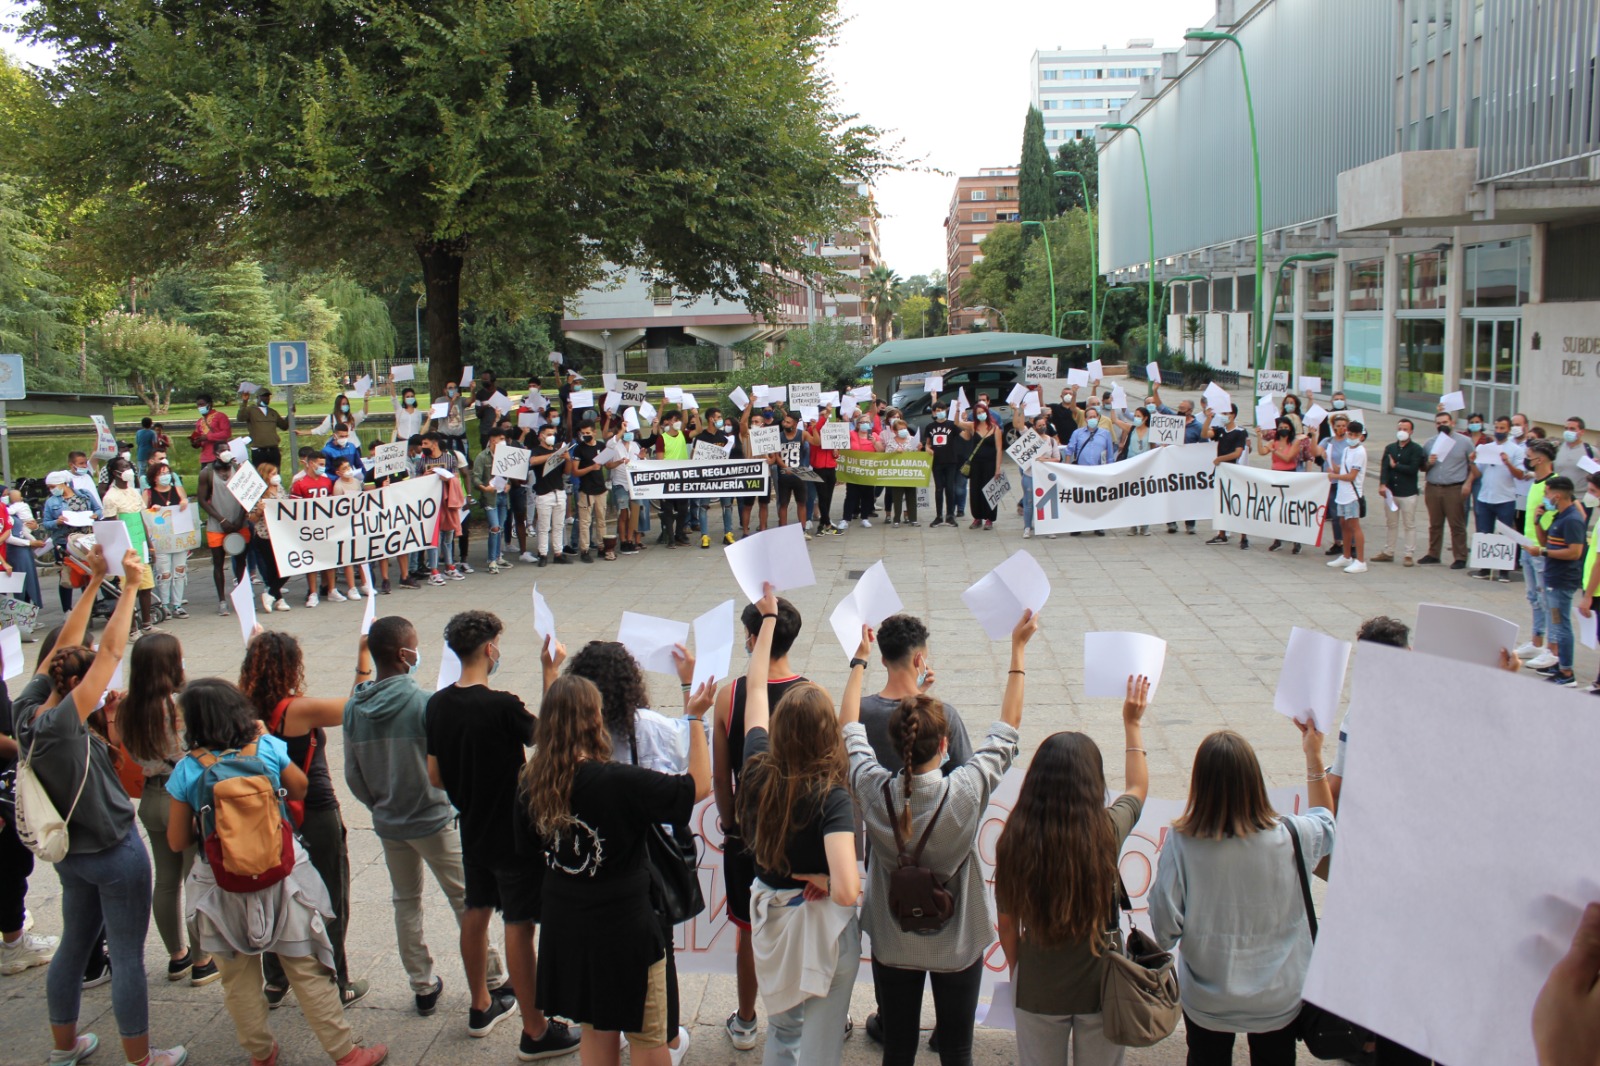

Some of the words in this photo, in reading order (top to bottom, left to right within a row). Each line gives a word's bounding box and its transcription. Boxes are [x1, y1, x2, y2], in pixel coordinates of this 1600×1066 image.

[280, 346, 298, 381] P
[1562, 359, 1585, 377] DEL
[622, 381, 639, 391] STOP
[929, 426, 952, 436] JAPAN
[1151, 415, 1184, 429] ¡REFORMA
[1158, 429, 1178, 441] YA!
[1012, 444, 1022, 457] NO
[496, 450, 528, 474] ¡BASTA!
[847, 456, 858, 465] UN
[860, 459, 889, 468] EFECTO
[890, 459, 930, 469] LLAMADA,
[633, 470, 681, 485] ¡REFORMA
[682, 468, 700, 479] DEL
[701, 464, 761, 477] REGLAMENTO
[846, 466, 875, 475] EFECTO
[877, 468, 925, 477] RESPUESTA.
[668, 482, 681, 491] DE
[682, 478, 744, 491] EXTRANJERÍA
[746, 480, 760, 488] YA!
[985, 483, 996, 498] NO
[988, 482, 1011, 506] TIEMPO
[277, 490, 384, 521] NINGÚN
[1246, 481, 1277, 522] HAY
[1271, 484, 1327, 528] TIEMPO
[299, 525, 334, 541] ser
[351, 497, 436, 537] HUMANO
[287, 549, 314, 568] es
[336, 521, 432, 565] ILEGAL
[1477, 541, 1514, 561] ¡BASTA!
